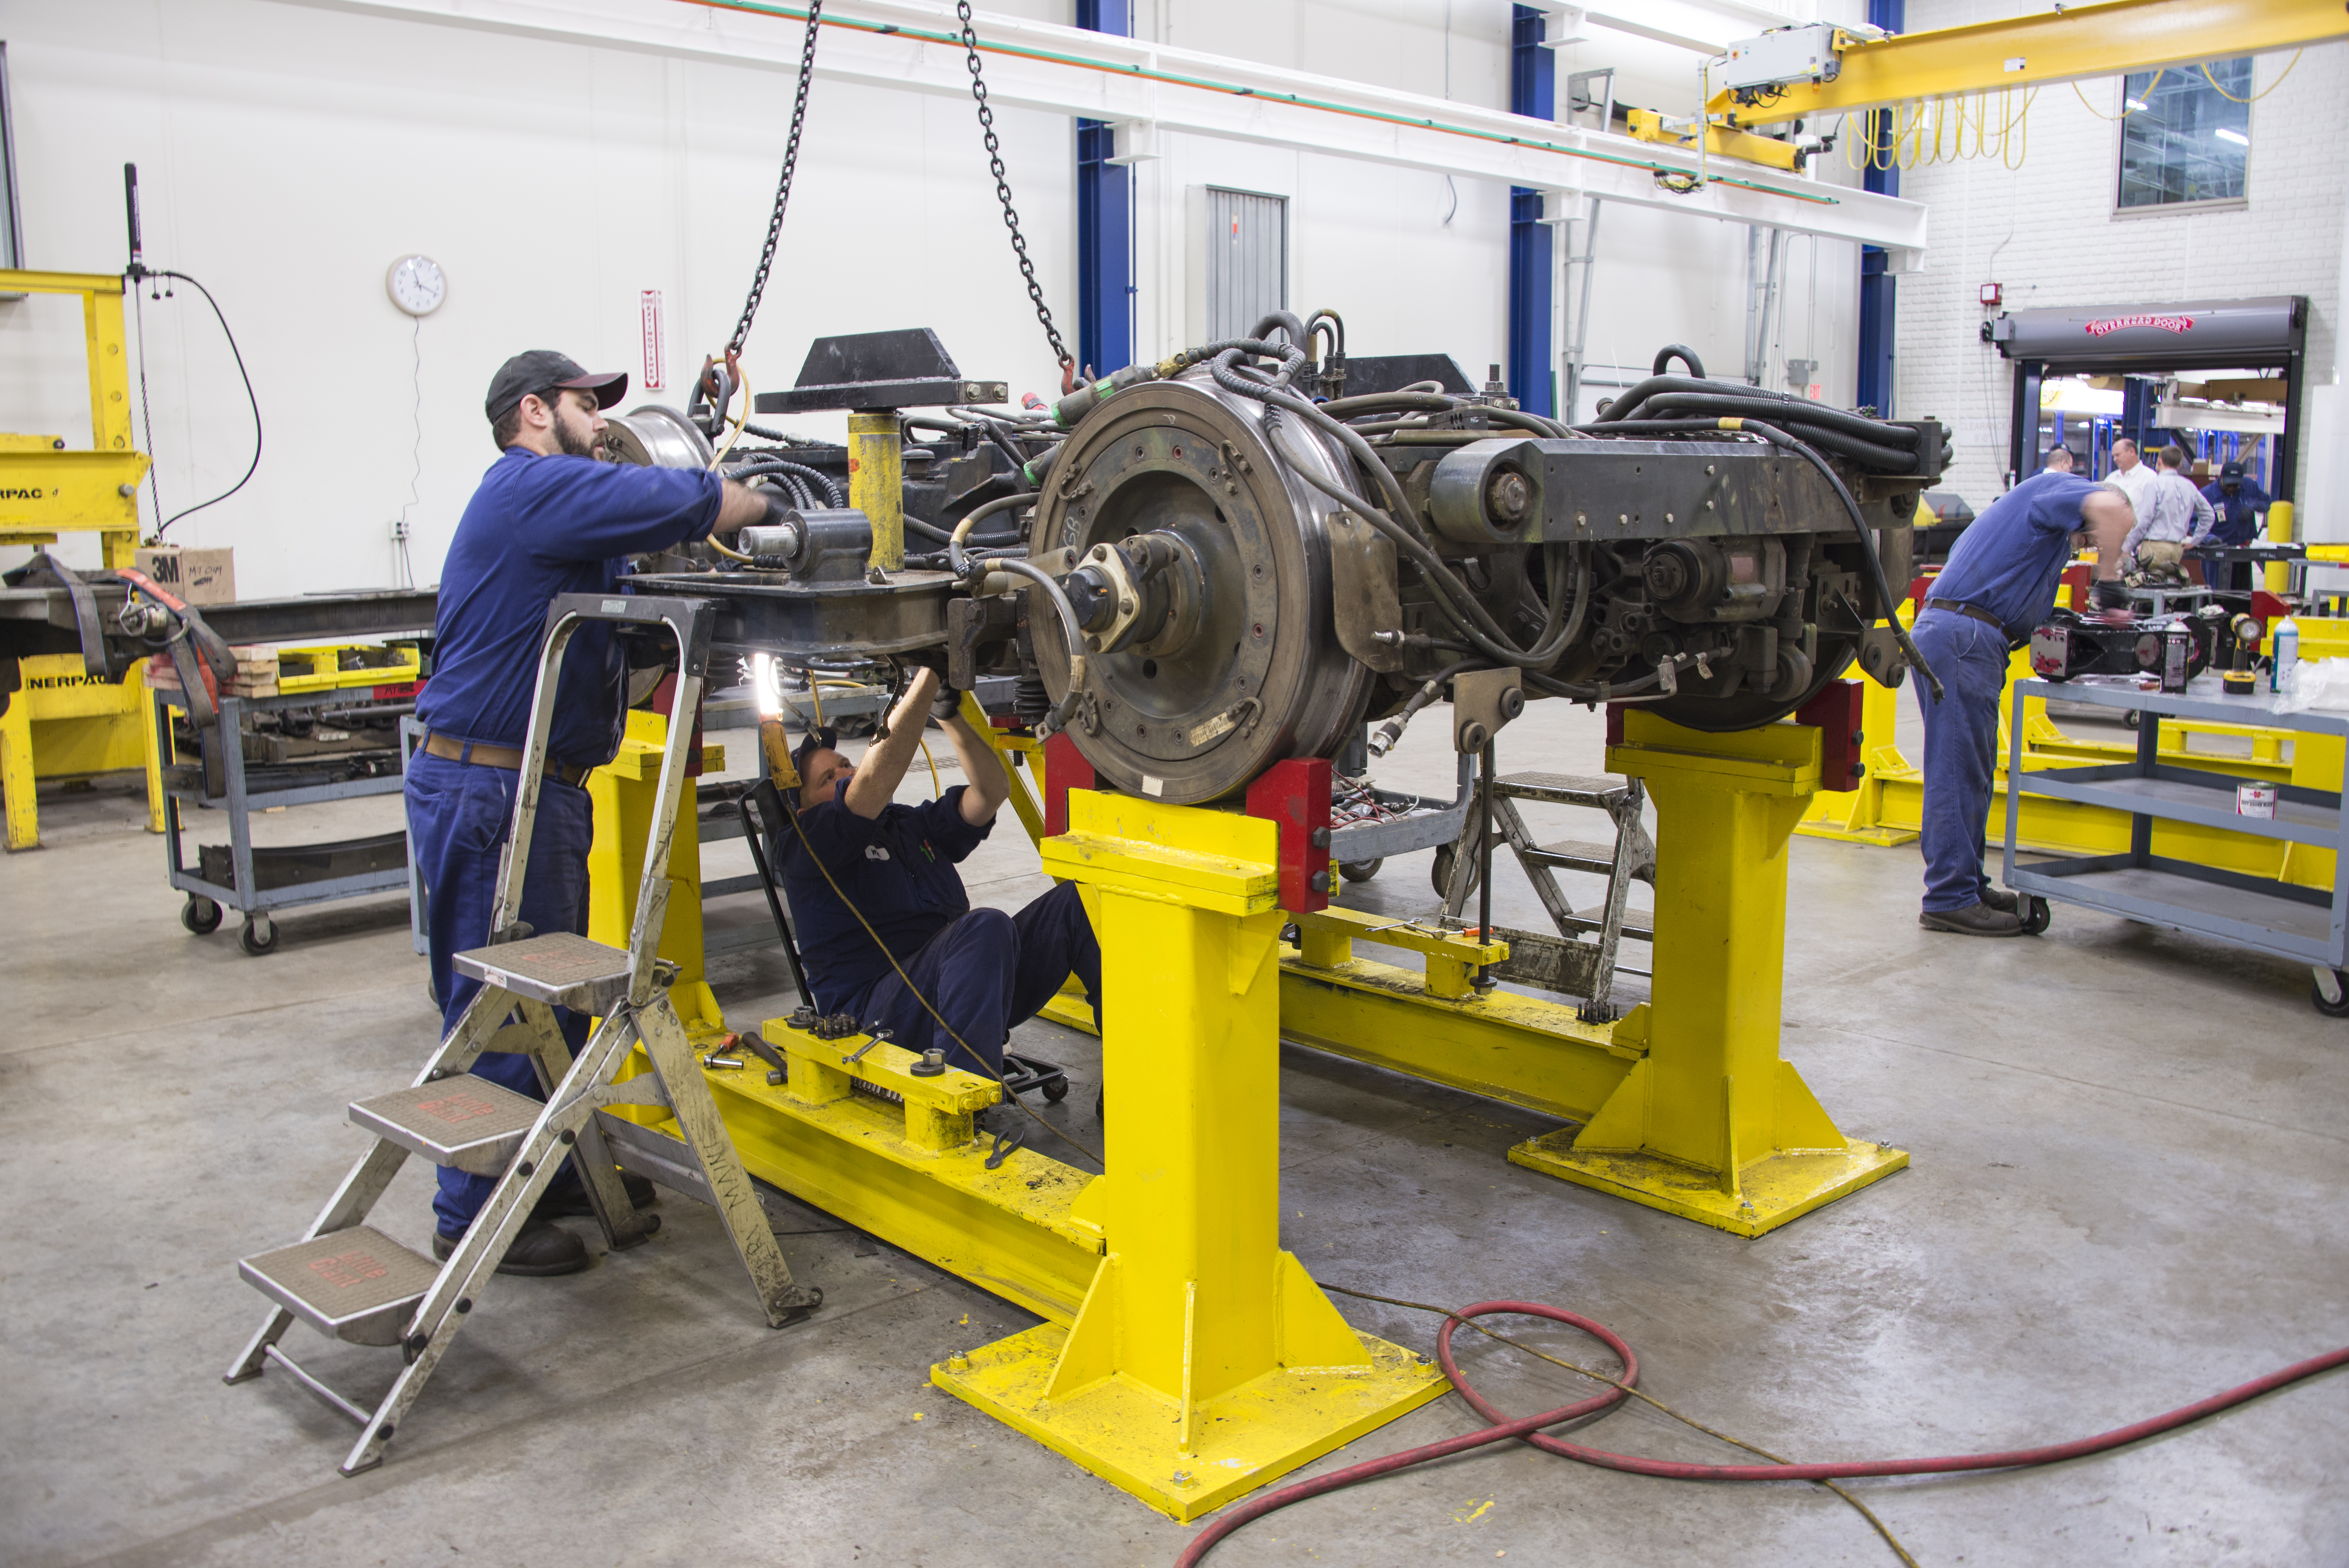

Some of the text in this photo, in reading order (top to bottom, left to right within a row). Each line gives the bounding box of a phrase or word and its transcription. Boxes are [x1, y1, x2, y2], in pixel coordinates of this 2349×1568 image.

[2096, 317, 2181, 335] OVERHEAD DOOR
[1960, 422, 2007, 431] CLEARANCE
[152, 556, 180, 583] 3M
[26, 675, 105, 690] NERPA
[309, 1258, 366, 1288] Giant
